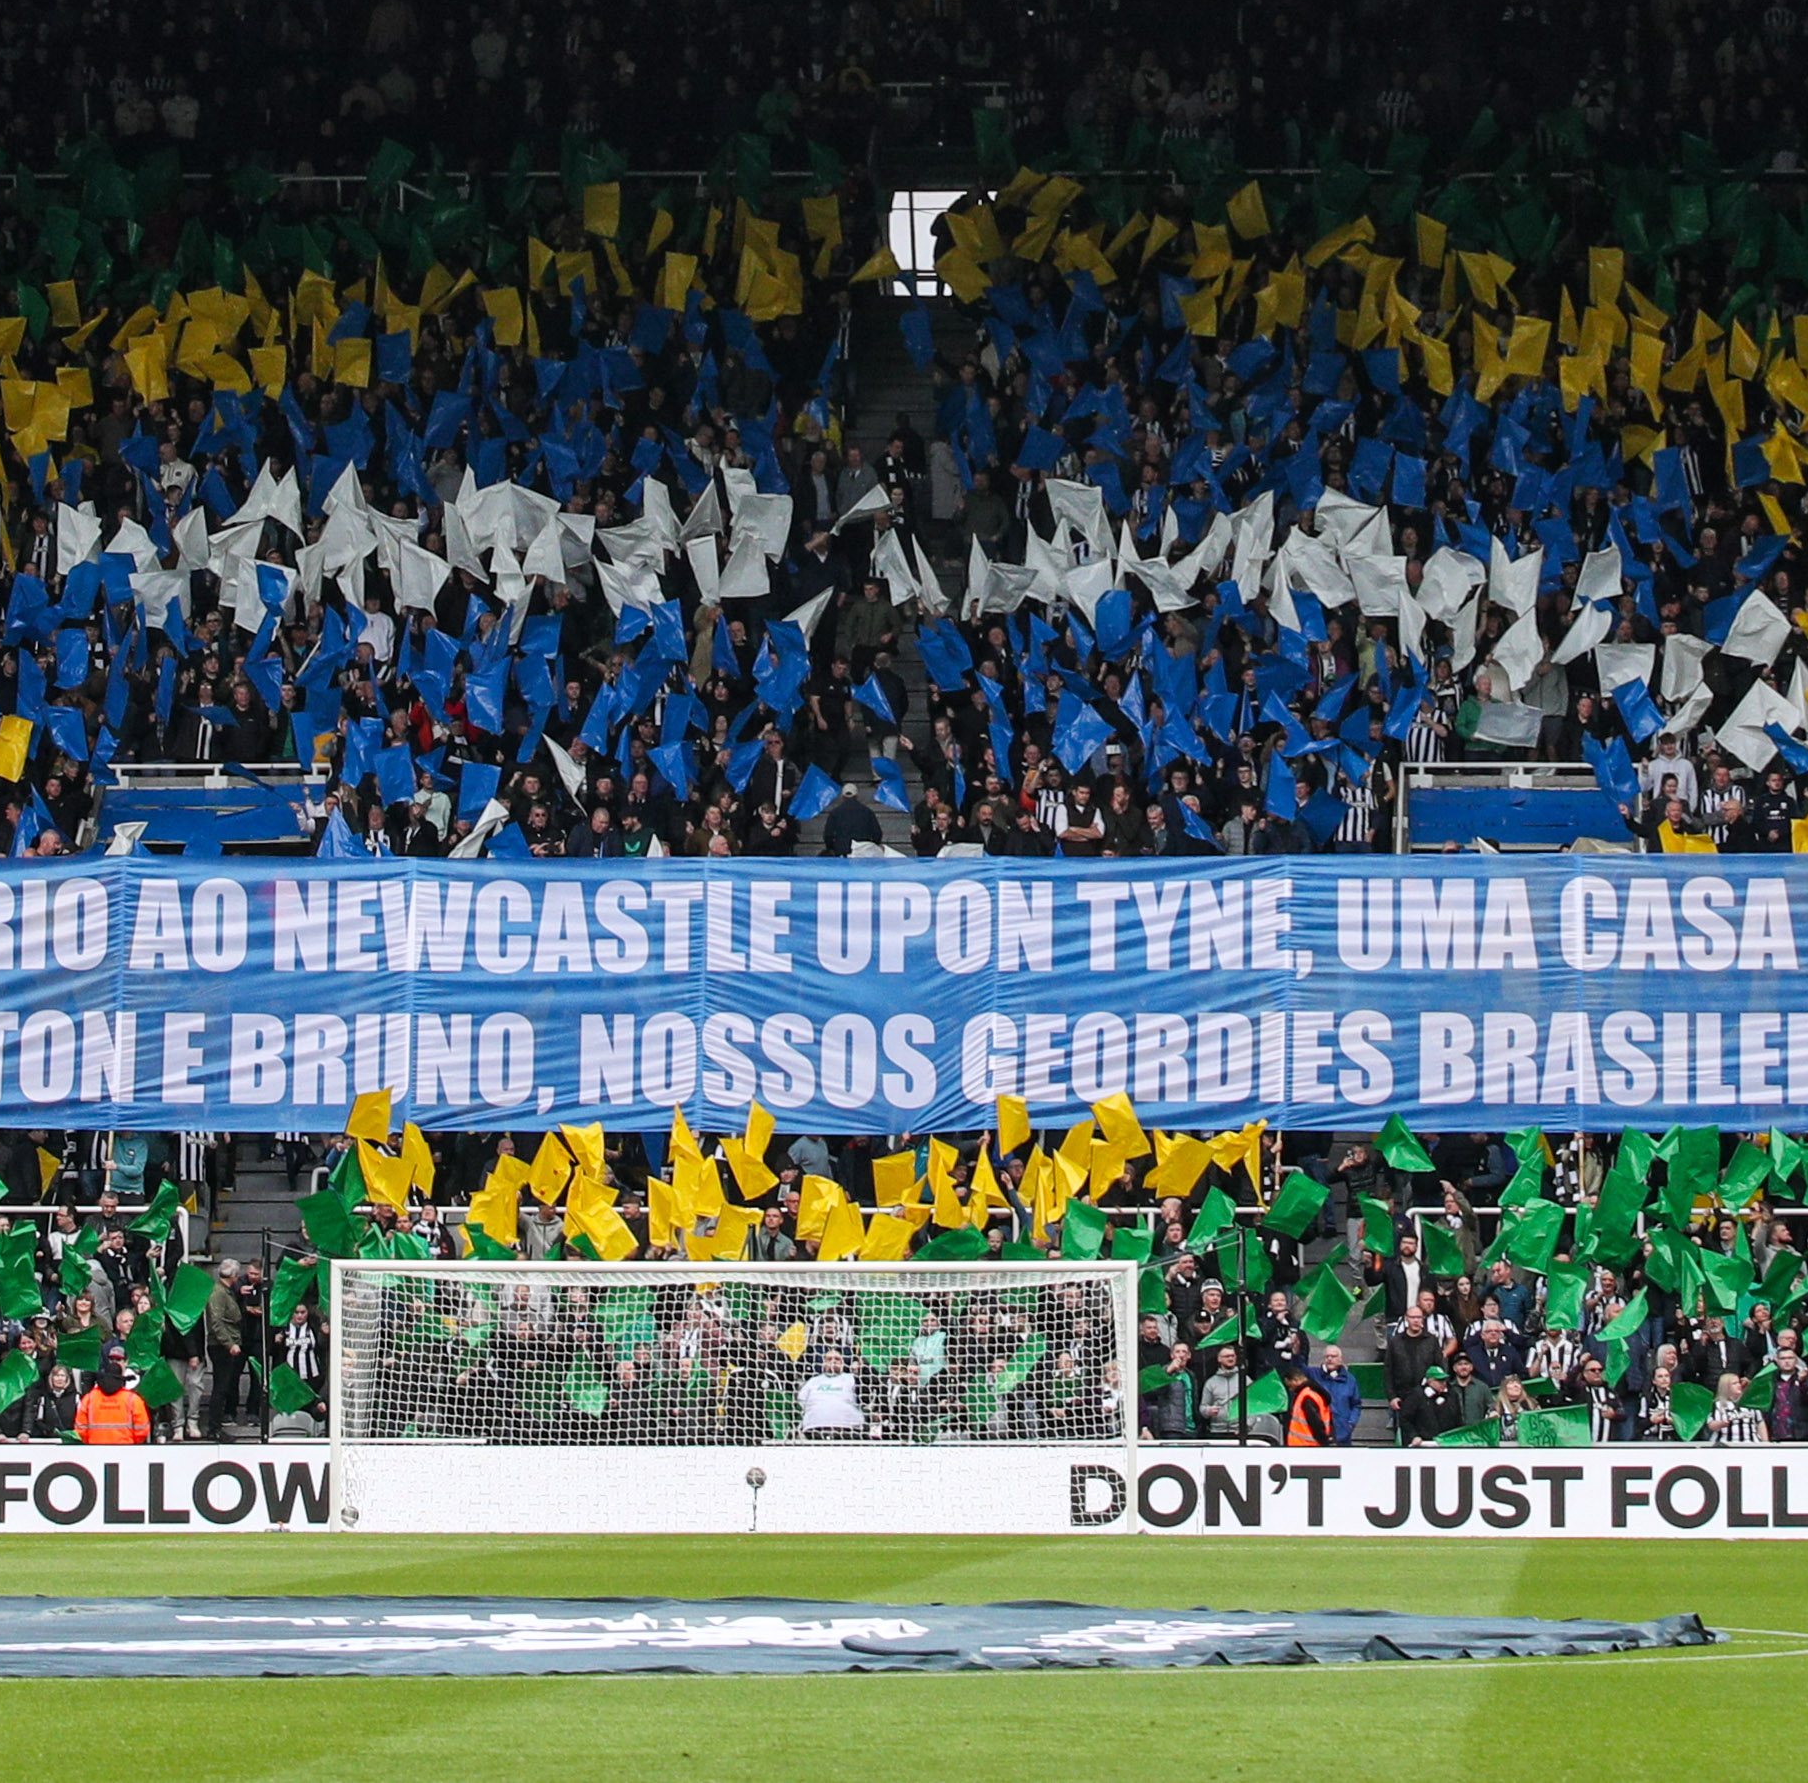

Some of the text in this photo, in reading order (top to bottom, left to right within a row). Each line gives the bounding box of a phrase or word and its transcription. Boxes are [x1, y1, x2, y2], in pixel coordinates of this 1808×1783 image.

[129, 878, 249, 973] AO
[273, 878, 793, 975] NEWCASTLE
[817, 880, 1054, 975] UPON
[1076, 879, 1315, 979] TYNE,
[1337, 878, 1543, 974] UMA
[1560, 876, 1802, 974] CASA
[162, 1013, 206, 1105] E
[229, 1013, 555, 1112] BRUNO,
[579, 1012, 938, 1110] NOSSOS
[962, 1010, 1394, 1106] GEORDIES
[1070, 1464, 1341, 1528] DON'T
[1365, 1466, 1584, 1529] JUST
